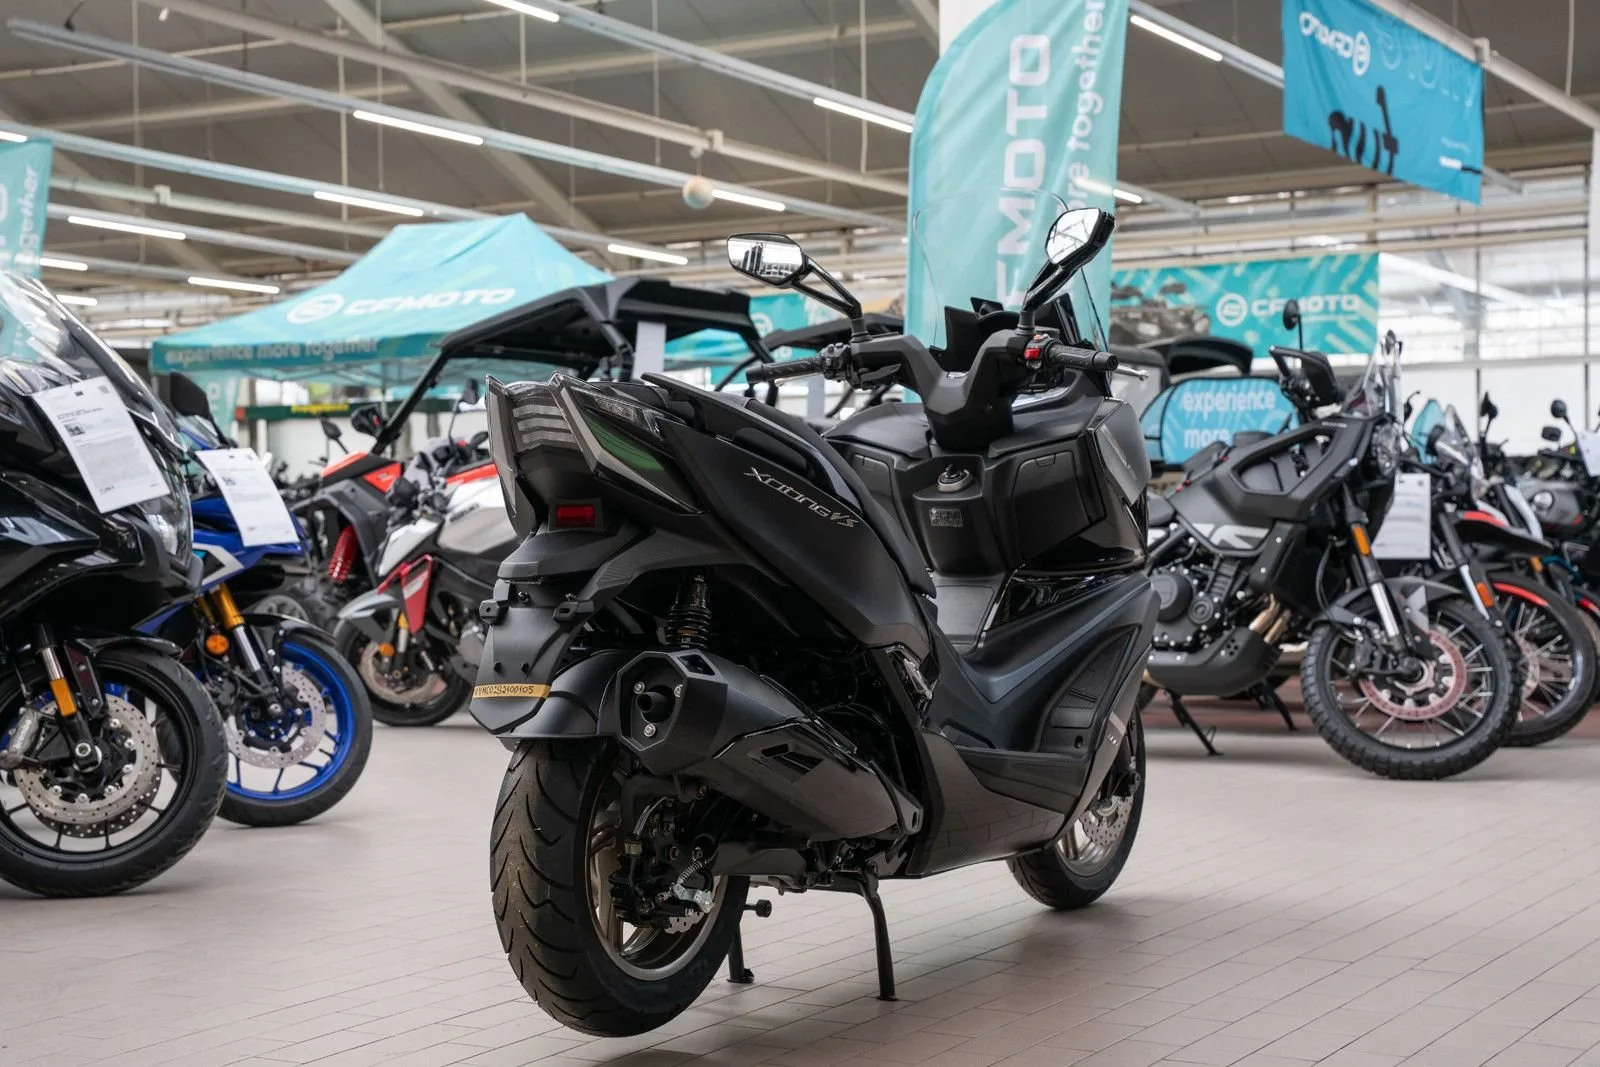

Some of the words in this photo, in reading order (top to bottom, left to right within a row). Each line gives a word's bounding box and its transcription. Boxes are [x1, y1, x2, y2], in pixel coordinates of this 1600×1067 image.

[996, 34, 1050, 308] FMOTO
[343, 287, 516, 316] CFMOTO
[165, 345, 253, 366] experience
[257, 342, 301, 358] more
[1182, 384, 1277, 421] experience
